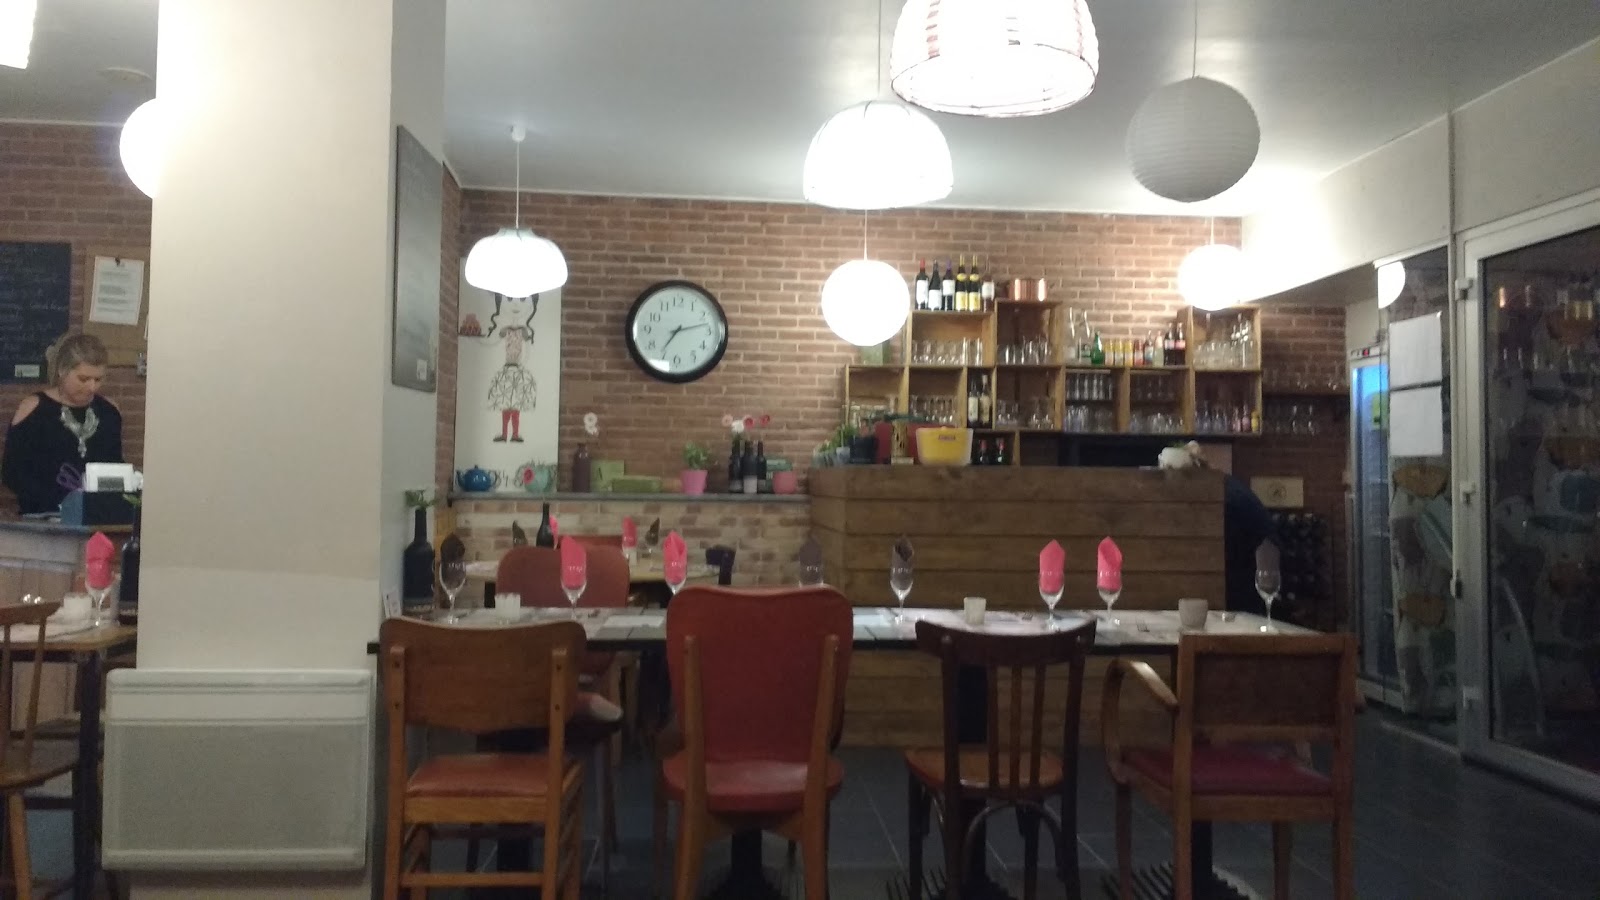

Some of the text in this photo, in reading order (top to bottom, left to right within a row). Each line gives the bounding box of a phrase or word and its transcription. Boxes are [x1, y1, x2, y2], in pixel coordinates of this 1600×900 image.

[660, 301, 669, 312] 11
[673, 296, 684, 308] 12
[649, 312, 661, 322] 10
[700, 311, 706, 320] 2
[643, 325, 652, 334] 9
[705, 326, 712, 336] 3
[648, 340, 656, 350] 8
[699, 339, 707, 350] 4
[673, 354, 681, 365] 6
[690, 350, 697, 361] 5
